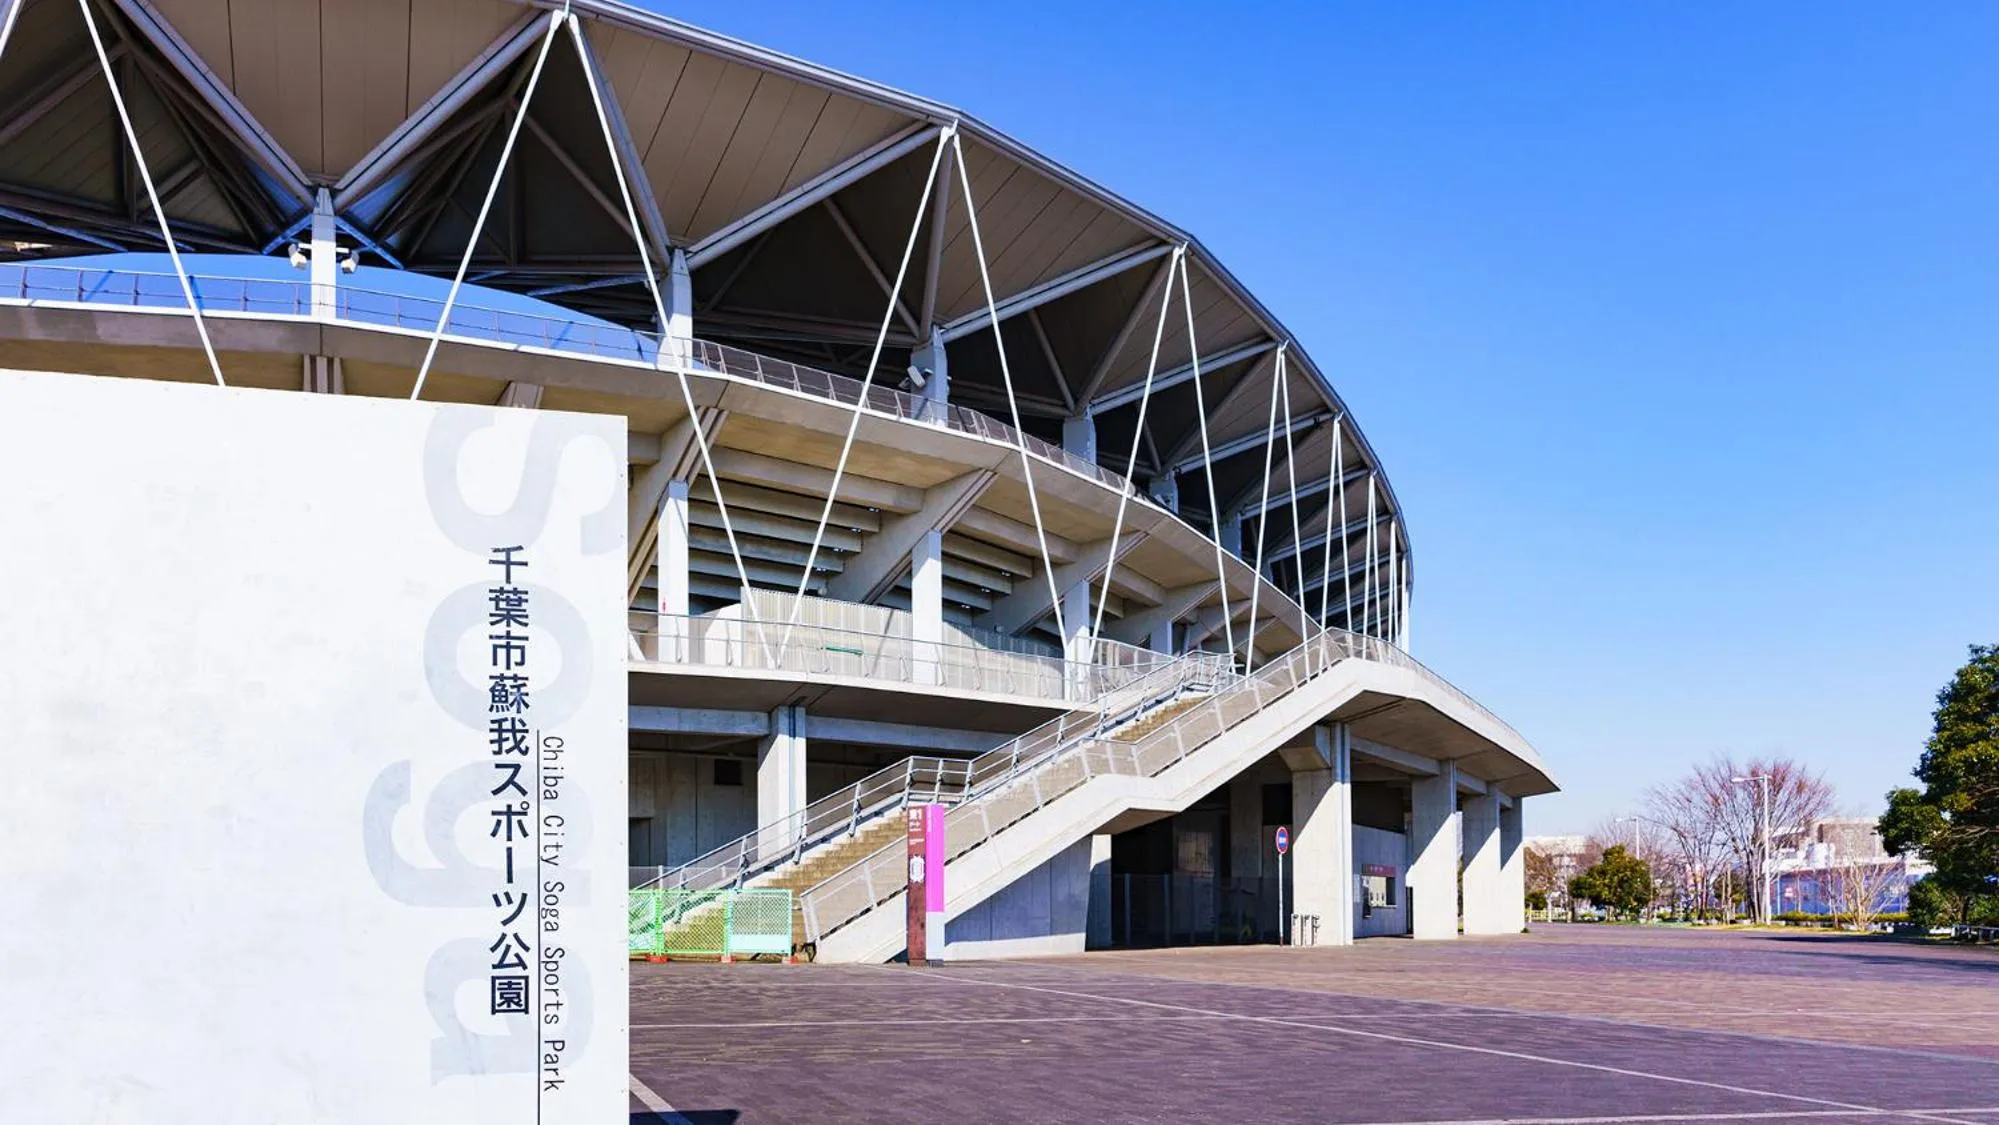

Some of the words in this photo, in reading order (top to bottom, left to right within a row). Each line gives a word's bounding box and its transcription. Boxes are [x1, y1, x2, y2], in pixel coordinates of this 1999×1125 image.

[364, 405, 626, 1086] Soga
[543, 736, 565, 801] Chiba
[488, 545, 531, 1016] 千葉市蘇我スポーツ公園
[540, 815, 565, 866] City
[541, 881, 565, 932] Soga
[541, 946, 566, 1025] Sports
[542, 1039, 566, 1092] Park
